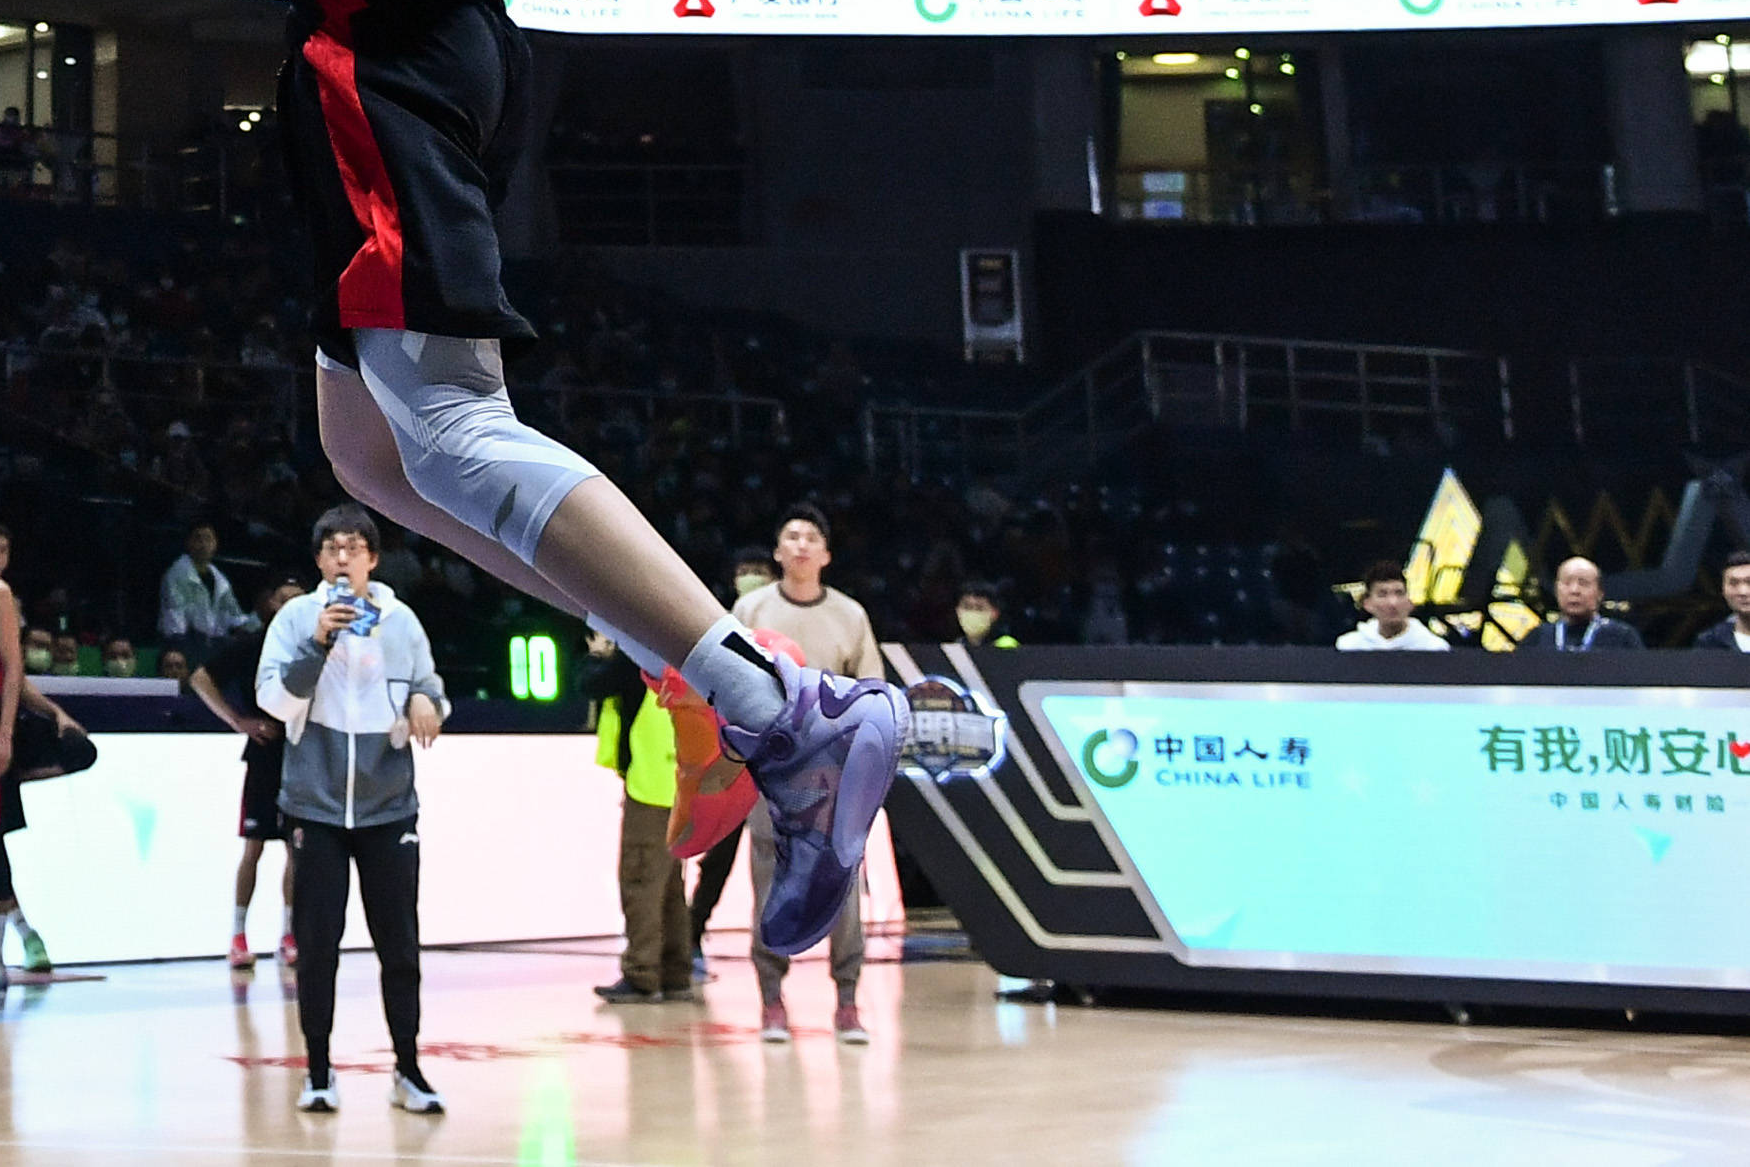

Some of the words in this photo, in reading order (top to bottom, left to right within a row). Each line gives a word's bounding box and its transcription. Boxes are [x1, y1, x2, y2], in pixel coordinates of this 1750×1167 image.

[510, 635, 558, 700] 10
[1154, 733, 1312, 765] 中国人寿
[1154, 769, 1242, 788] CHINA
[1253, 771, 1312, 789] LIFE
